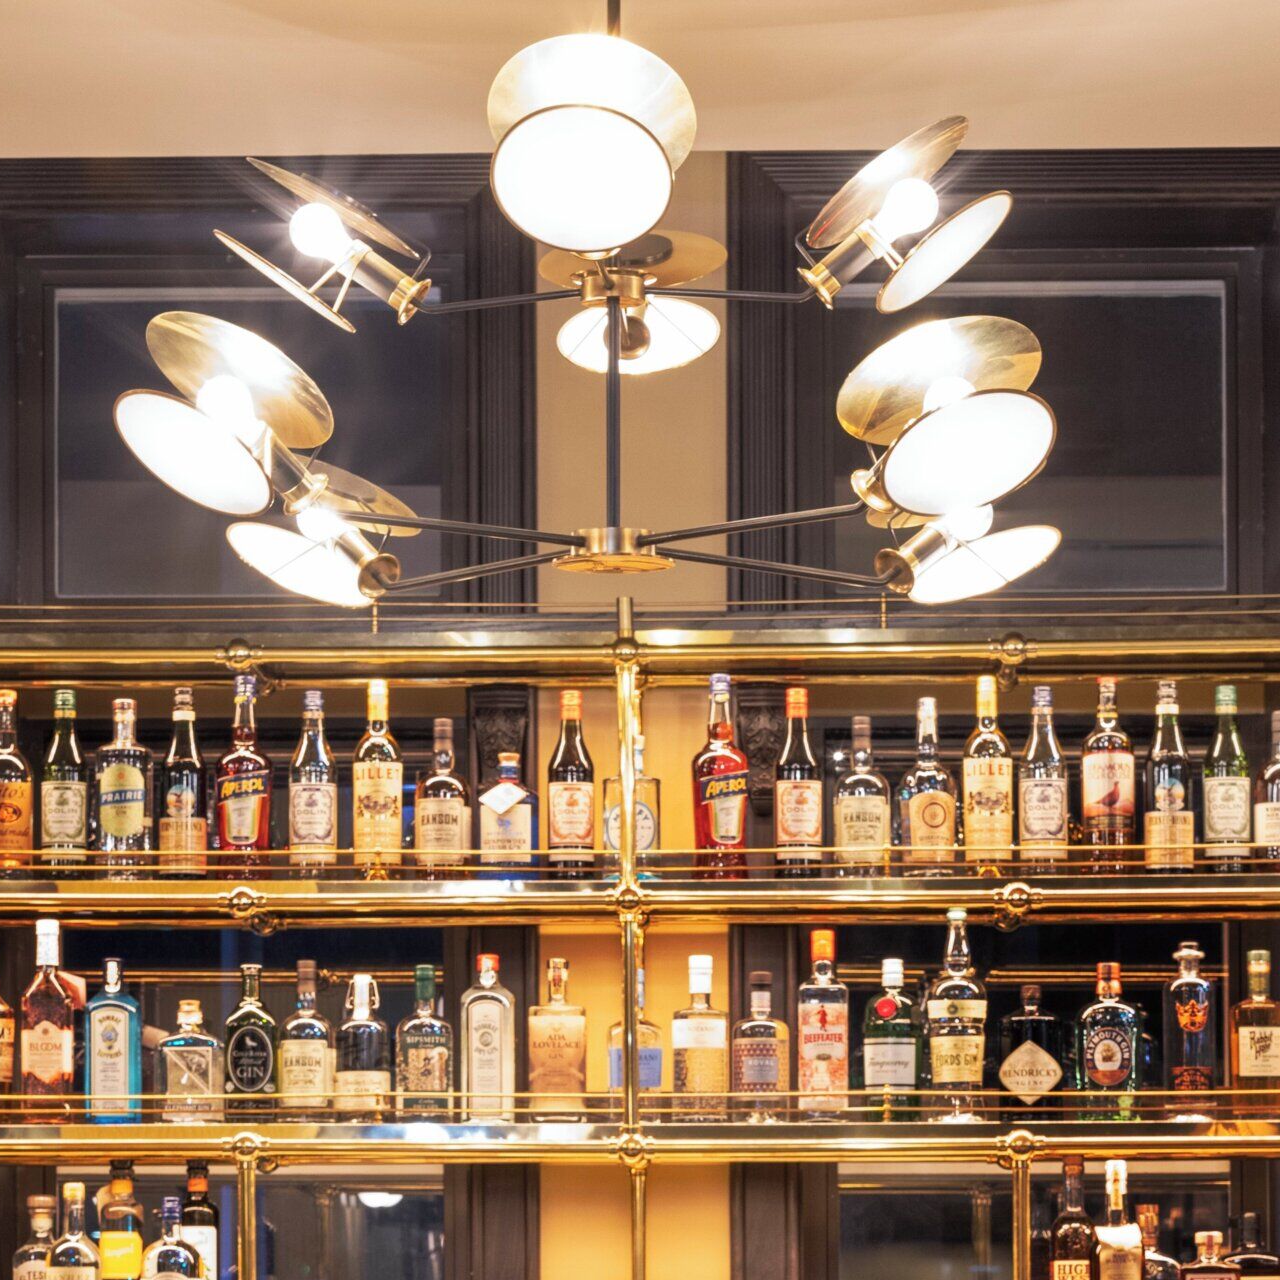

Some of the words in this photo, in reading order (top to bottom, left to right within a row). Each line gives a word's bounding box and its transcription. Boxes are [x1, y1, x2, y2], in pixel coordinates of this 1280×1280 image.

[966, 763, 1011, 777] LILLET
[221, 777, 264, 799] APEROL
[705, 777, 746, 798] APEROL
[100, 790, 143, 803] PRAIRIE
[421, 813, 459, 826] RANSOM
[843, 812, 881, 824] RANSOM
[406, 1035, 446, 1044] SIPSMITH
[804, 1033, 843, 1043] BEEFEATER
[29, 1043, 62, 1051] BLOOM
[532, 1041, 580, 1049] LOVELACE
[1086, 1031, 1125, 1060] PLYMOUTH
[1119, 1037, 1131, 1059] GIN
[283, 1056, 321, 1067] RANSOM
[867, 1056, 910, 1069] Tanqueray
[936, 1053, 961, 1066] FORDS
[963, 1053, 979, 1066] GIN
[236, 1065, 265, 1078] GIN
[1003, 1068, 1058, 1078] HENDRICK'S
